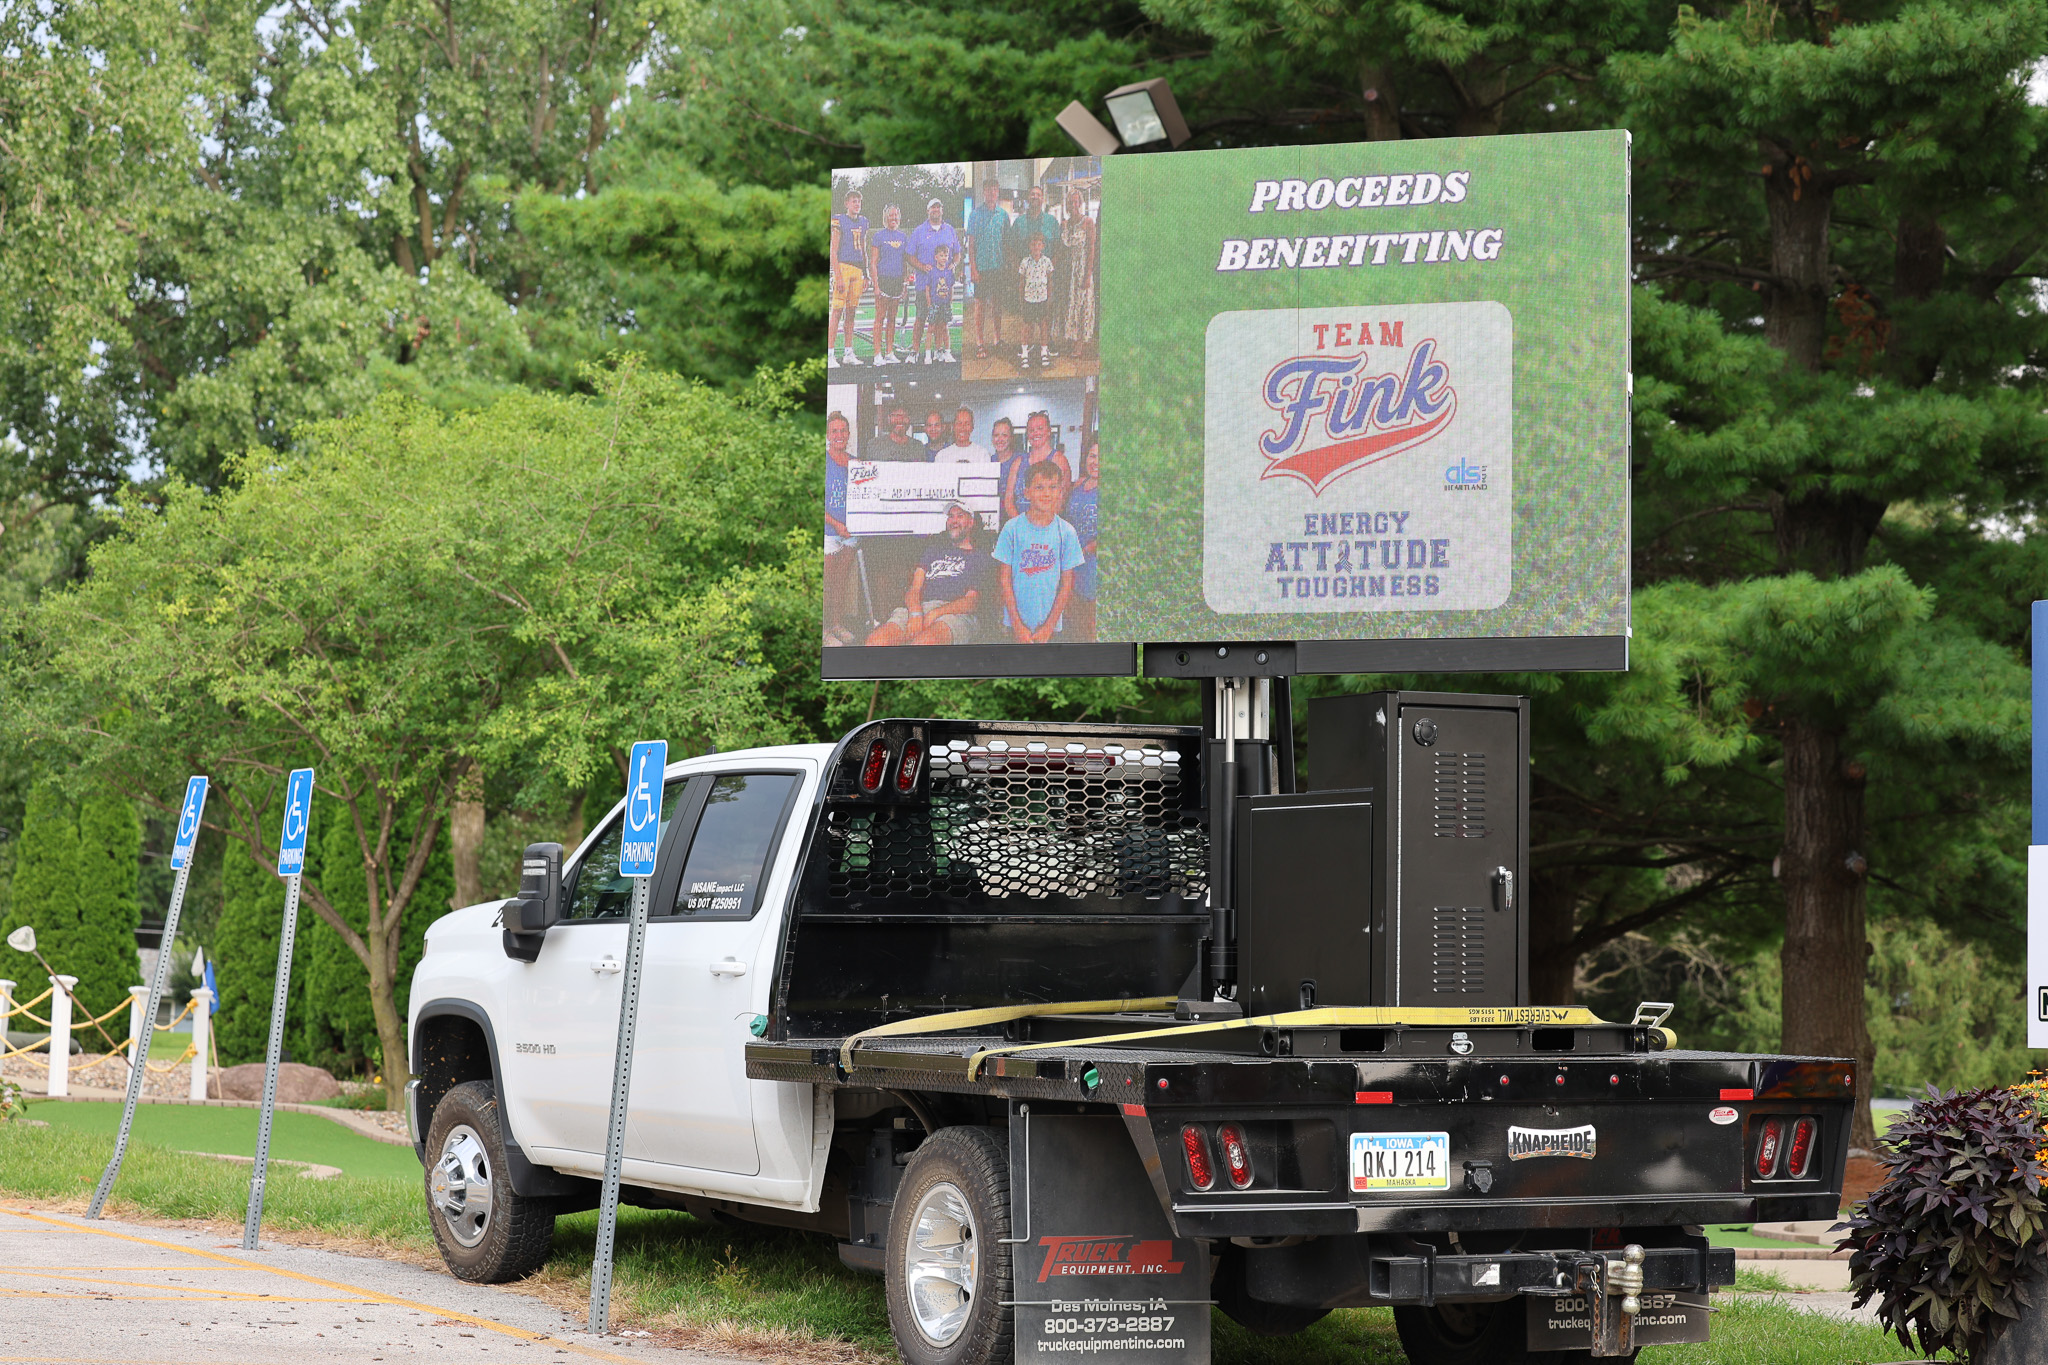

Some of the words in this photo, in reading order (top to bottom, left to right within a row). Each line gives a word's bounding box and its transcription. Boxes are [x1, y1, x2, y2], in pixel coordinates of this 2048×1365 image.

[1249, 171, 1470, 212] PROCEEDS
[1216, 229, 1503, 271] BENEFITTING
[1313, 321, 1404, 349] TEAM
[1261, 341, 1452, 456] Fink
[1304, 511, 1410, 536] ENERGY
[1277, 575, 1440, 598] TOUGHNESS
[280, 848, 302, 865] PARKING
[623, 841, 655, 862] PARKING
[690, 881, 717, 893] INSANE
[716, 884, 734, 894] impact
[734, 883, 745, 892] LLC
[688, 898, 697, 908] US
[697, 898, 711, 908] DOT
[711, 897, 742, 909] #250951
[1498, 1009, 1514, 1022] WLL
[1515, 1009, 1551, 1022] EVEREST
[516, 1043, 541, 1054] 3500
[543, 1044, 557, 1054] HD
[1386, 1138, 1414, 1149] IOWA
[1512, 1130, 1592, 1155] KNAPHEIDE
[1363, 1151, 1397, 1178] QKJ
[1405, 1150, 1436, 1177] 214
[1037, 1235, 1133, 1283] TRUCK
[1061, 1265, 1136, 1275] EQUIPMENT,
[1141, 1264, 1168, 1274] INC.
[1051, 1299, 1081, 1313] Des
[1084, 1298, 1146, 1314] Moines,
[1149, 1298, 1168, 1311] IA
[1044, 1316, 1175, 1334] 800-373-2887
[1037, 1336, 1185, 1354] truckequipmentinc.com
